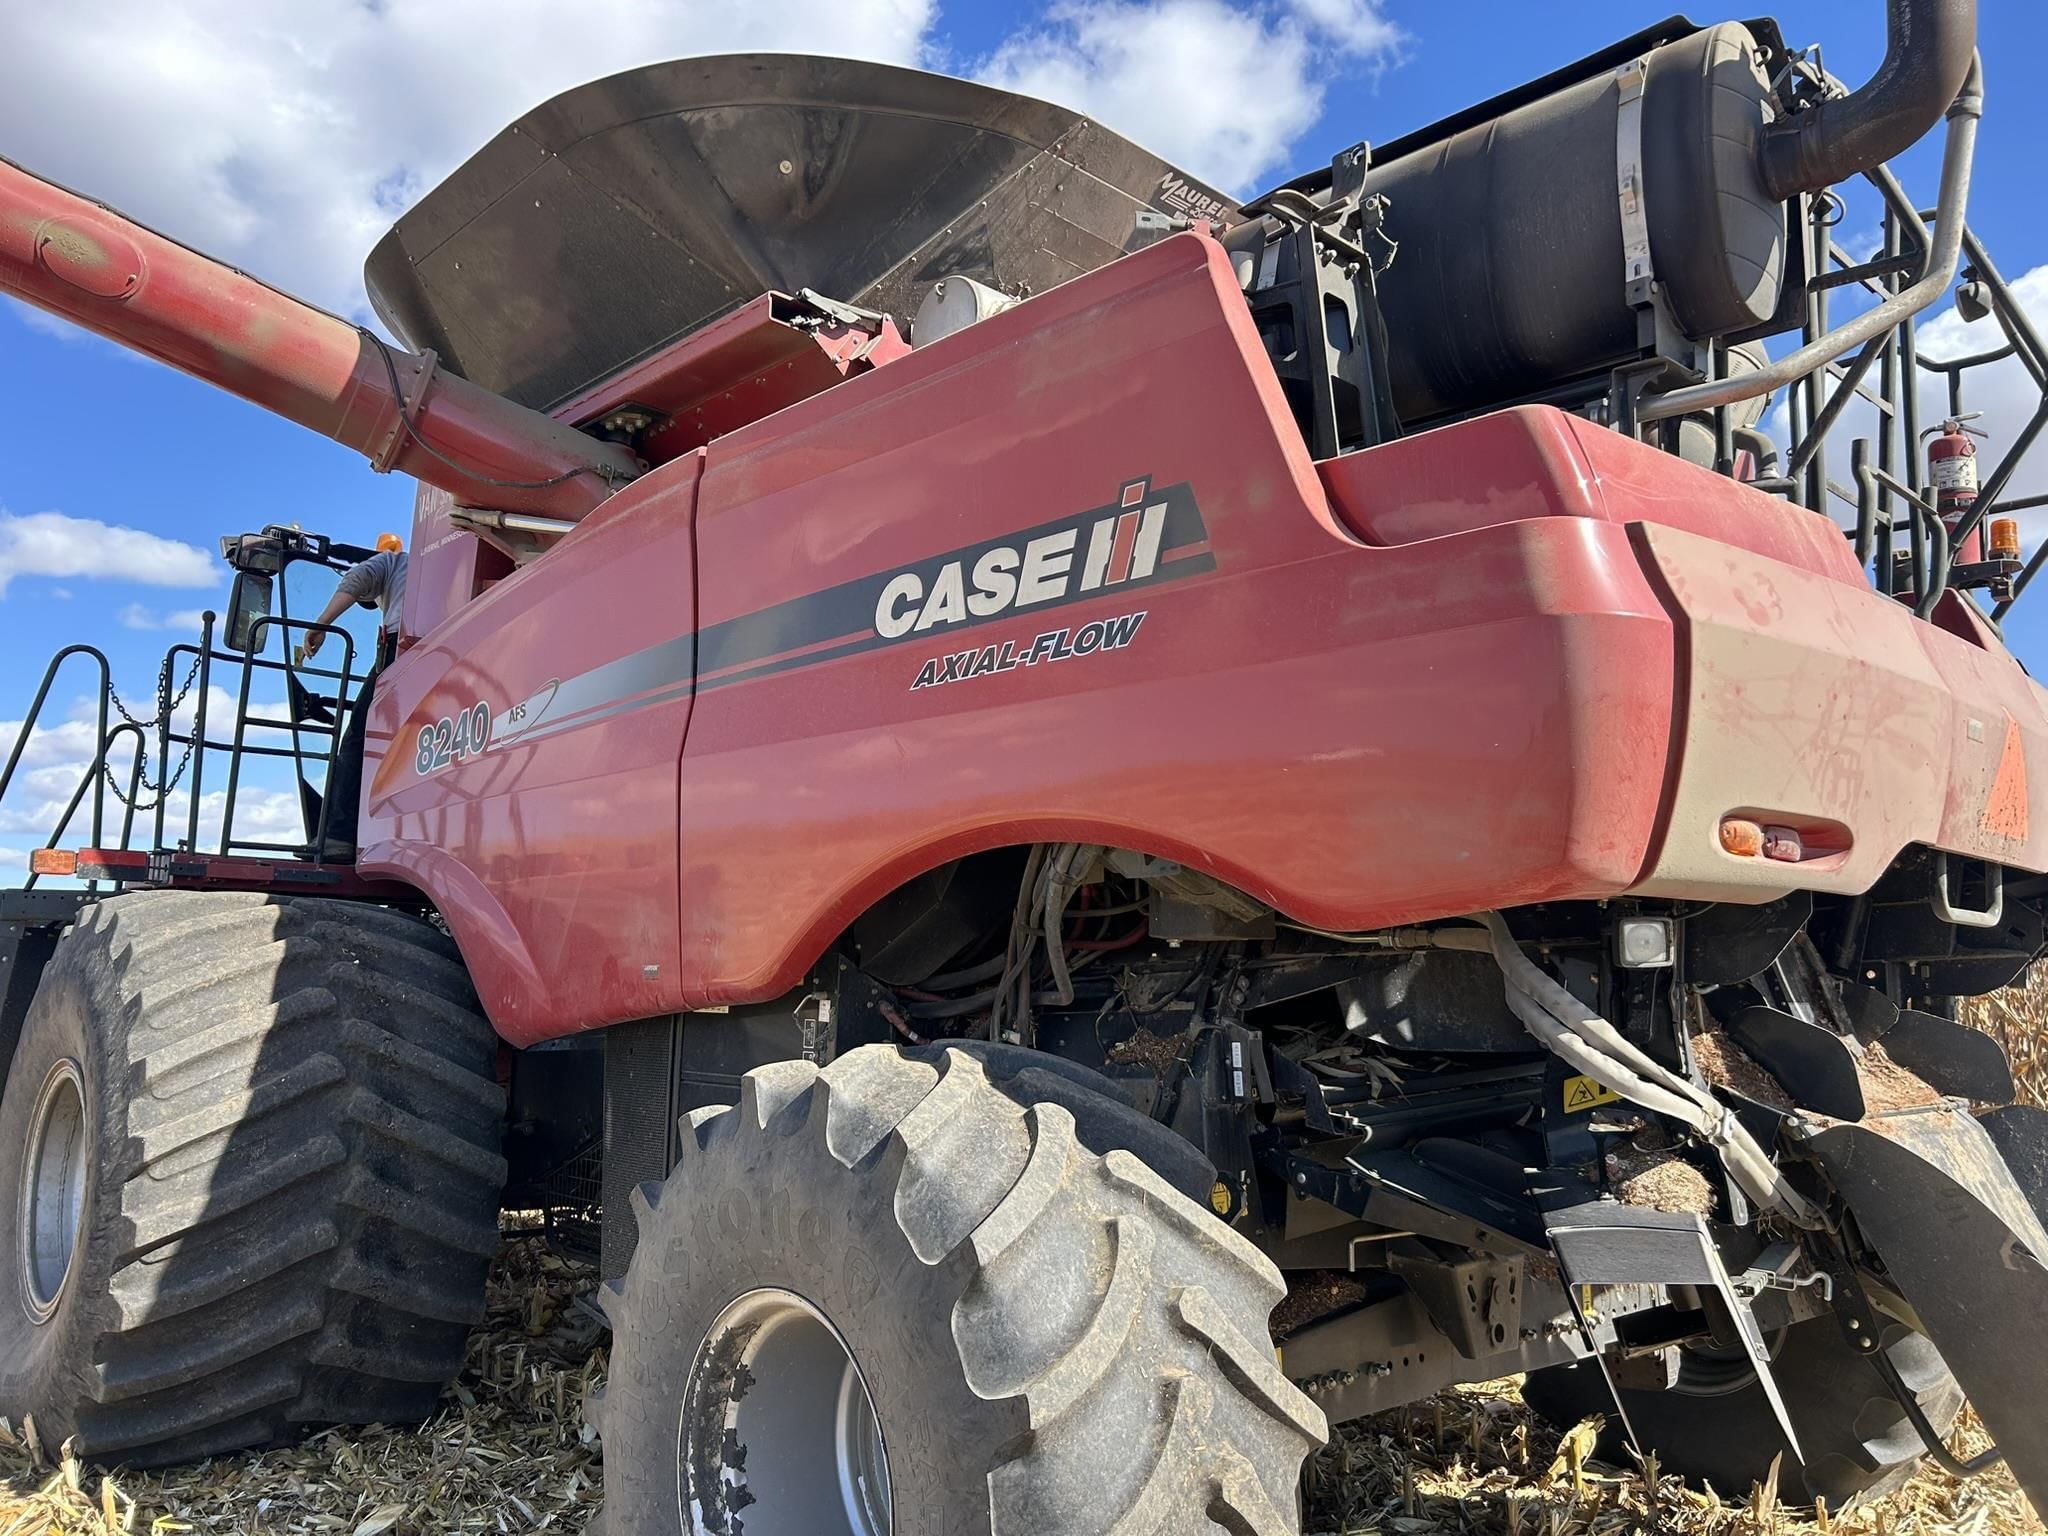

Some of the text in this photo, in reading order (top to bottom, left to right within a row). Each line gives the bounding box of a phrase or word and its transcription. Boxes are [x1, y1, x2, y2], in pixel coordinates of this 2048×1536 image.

[875, 528, 1078, 639] CASE
[909, 611, 1147, 691] AXIAL-FLOW
[415, 700, 527, 776] 8240 AFS
